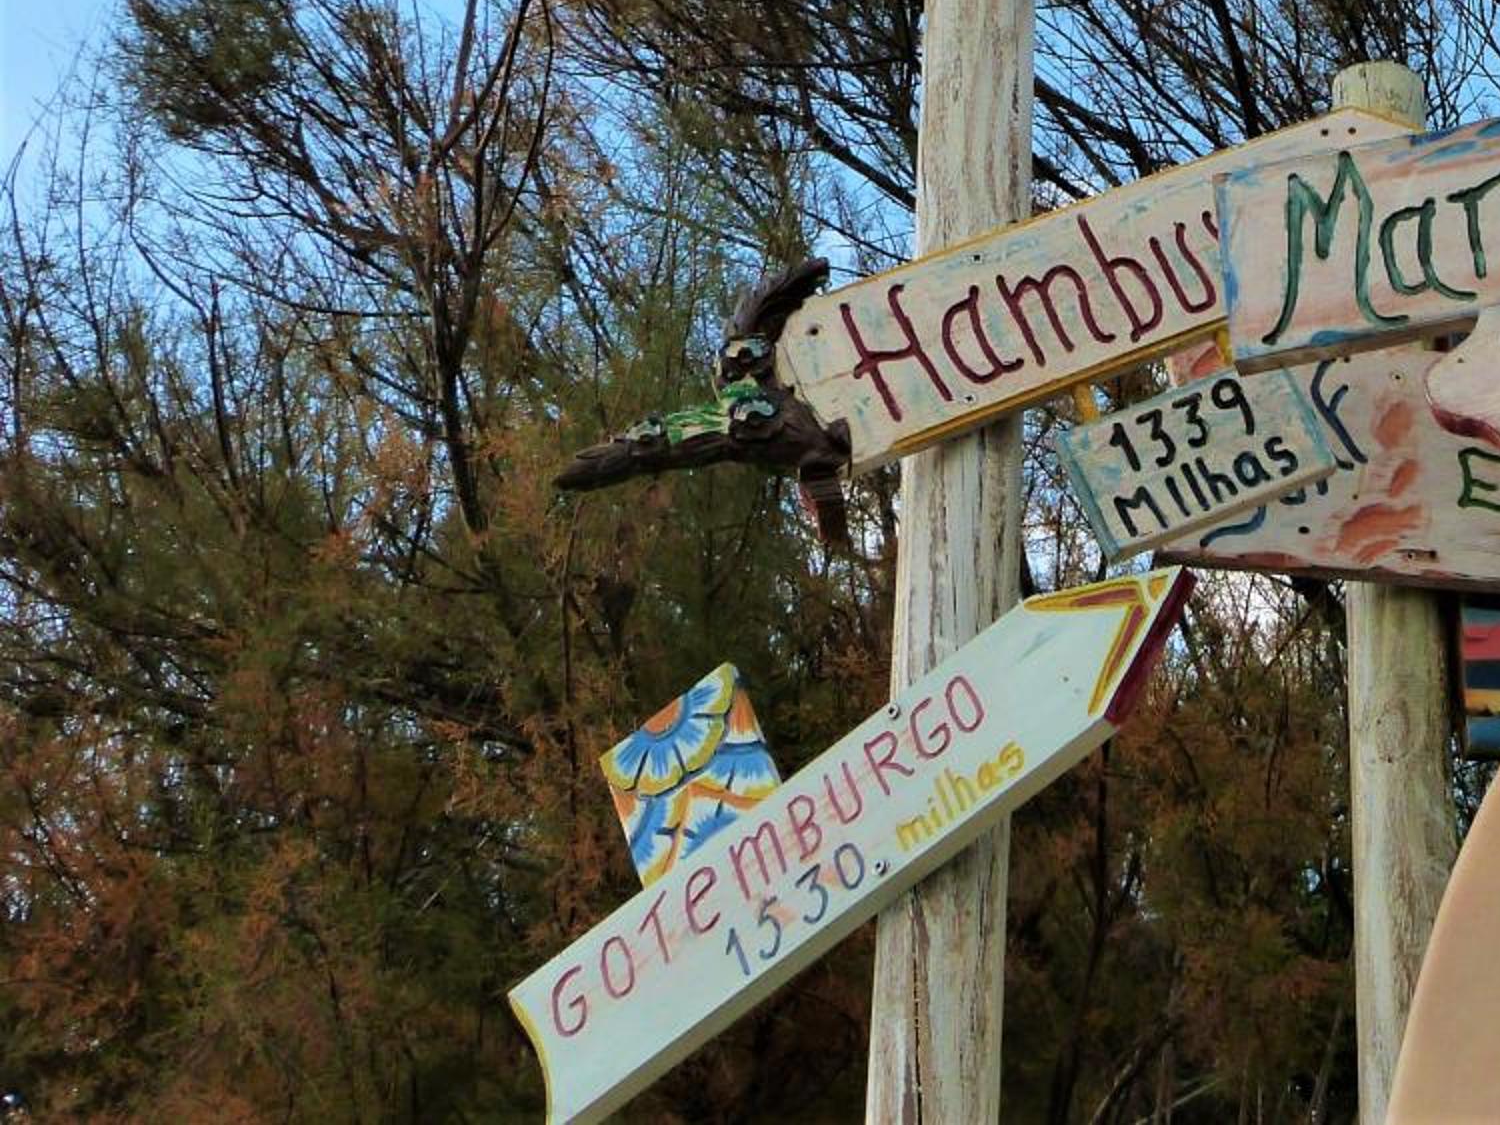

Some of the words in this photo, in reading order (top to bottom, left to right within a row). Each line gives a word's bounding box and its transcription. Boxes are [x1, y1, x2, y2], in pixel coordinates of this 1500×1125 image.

[839, 210, 1219, 421] Hambu
[1109, 378, 1254, 471] 1339
[726, 842, 865, 976] 1530
[895, 741, 1026, 852] milhas
